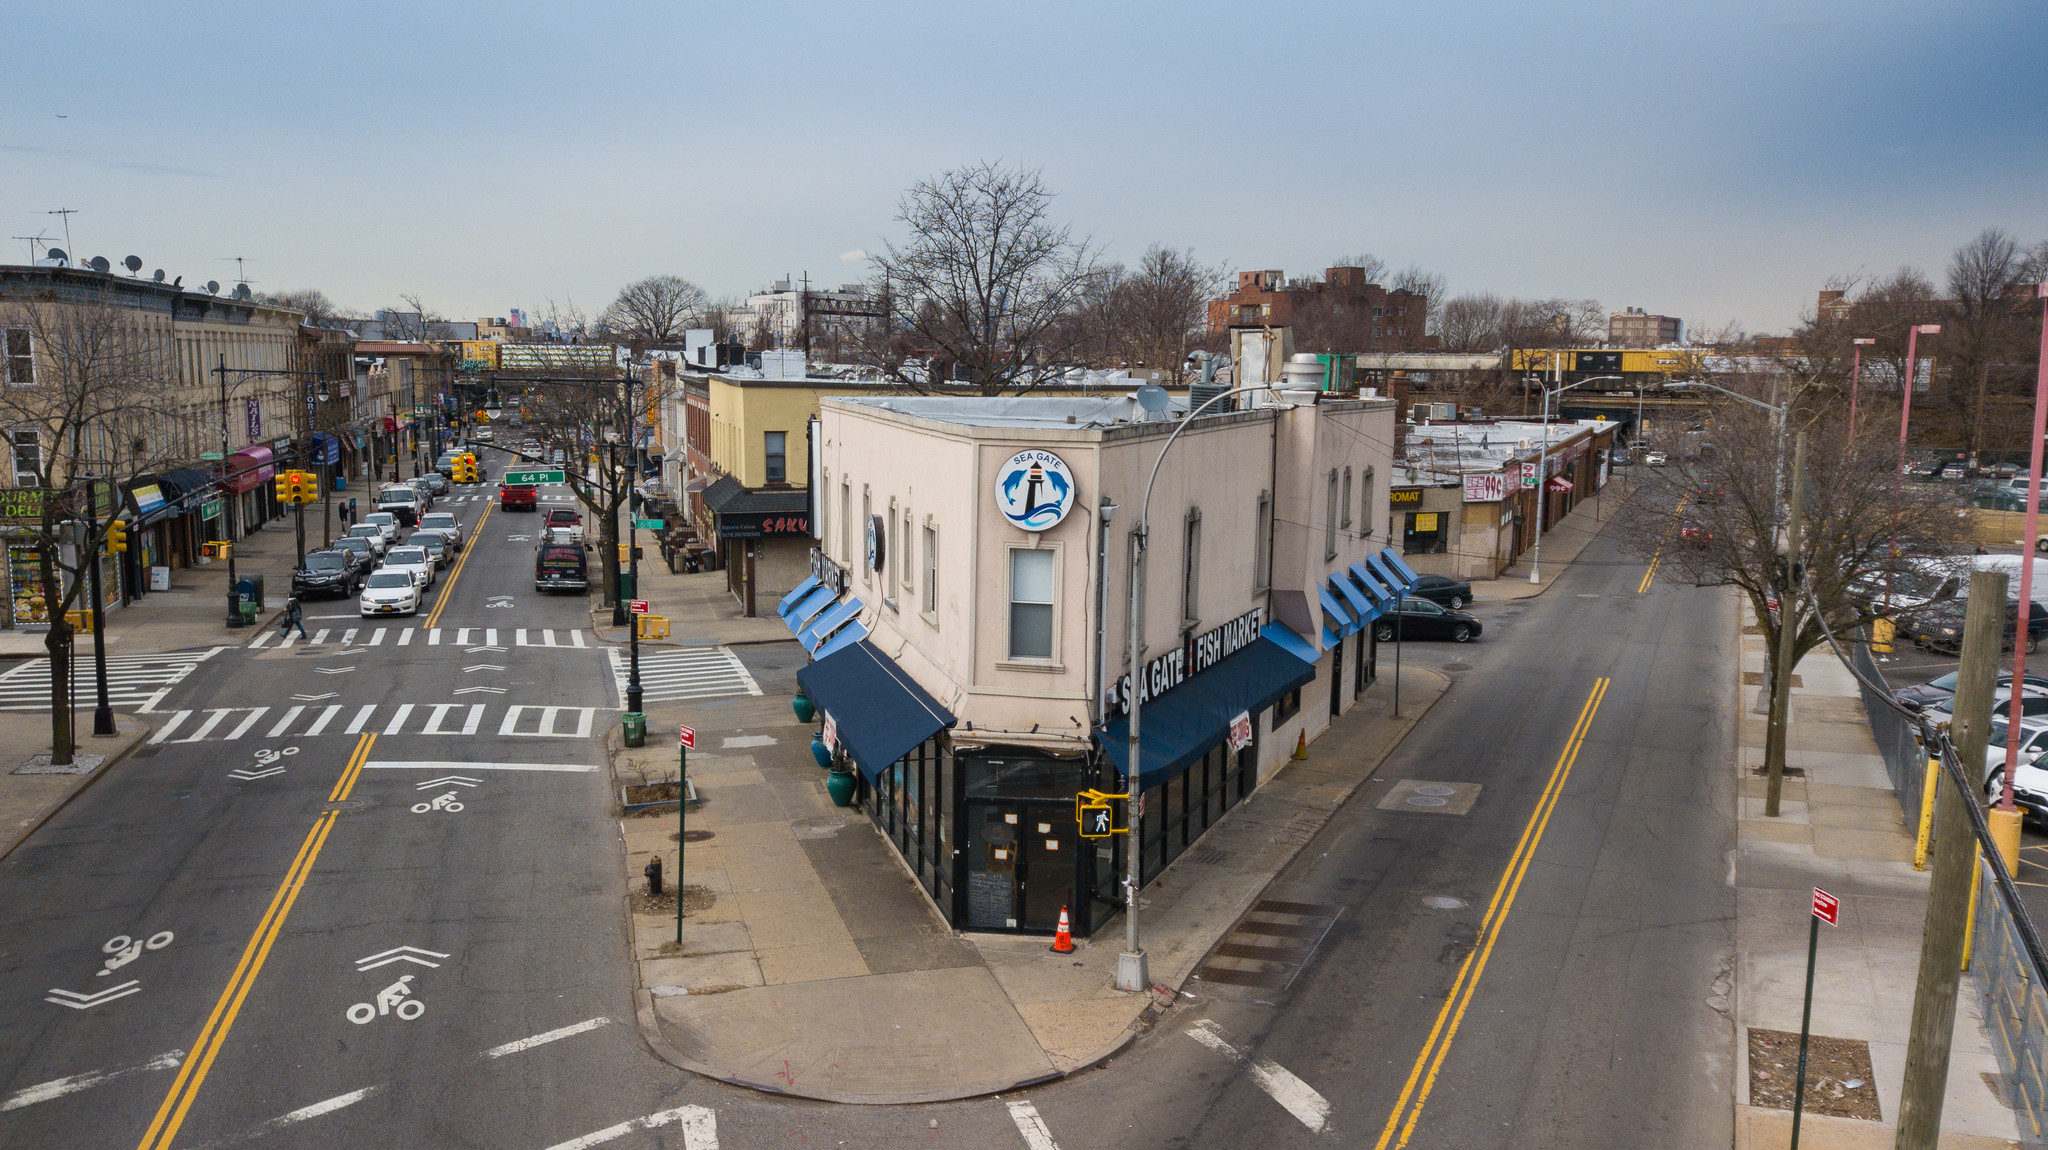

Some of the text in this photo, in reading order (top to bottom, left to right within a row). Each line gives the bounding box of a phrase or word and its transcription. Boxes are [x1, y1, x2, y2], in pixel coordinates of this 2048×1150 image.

[248, 400, 259, 435] NAILS
[1013, 452, 1062, 469] SEA GATE
[521, 474, 535, 482] 64
[5, 505, 42, 517] DELI
[1121, 607, 1263, 715] SA GATE FISH MARKET
